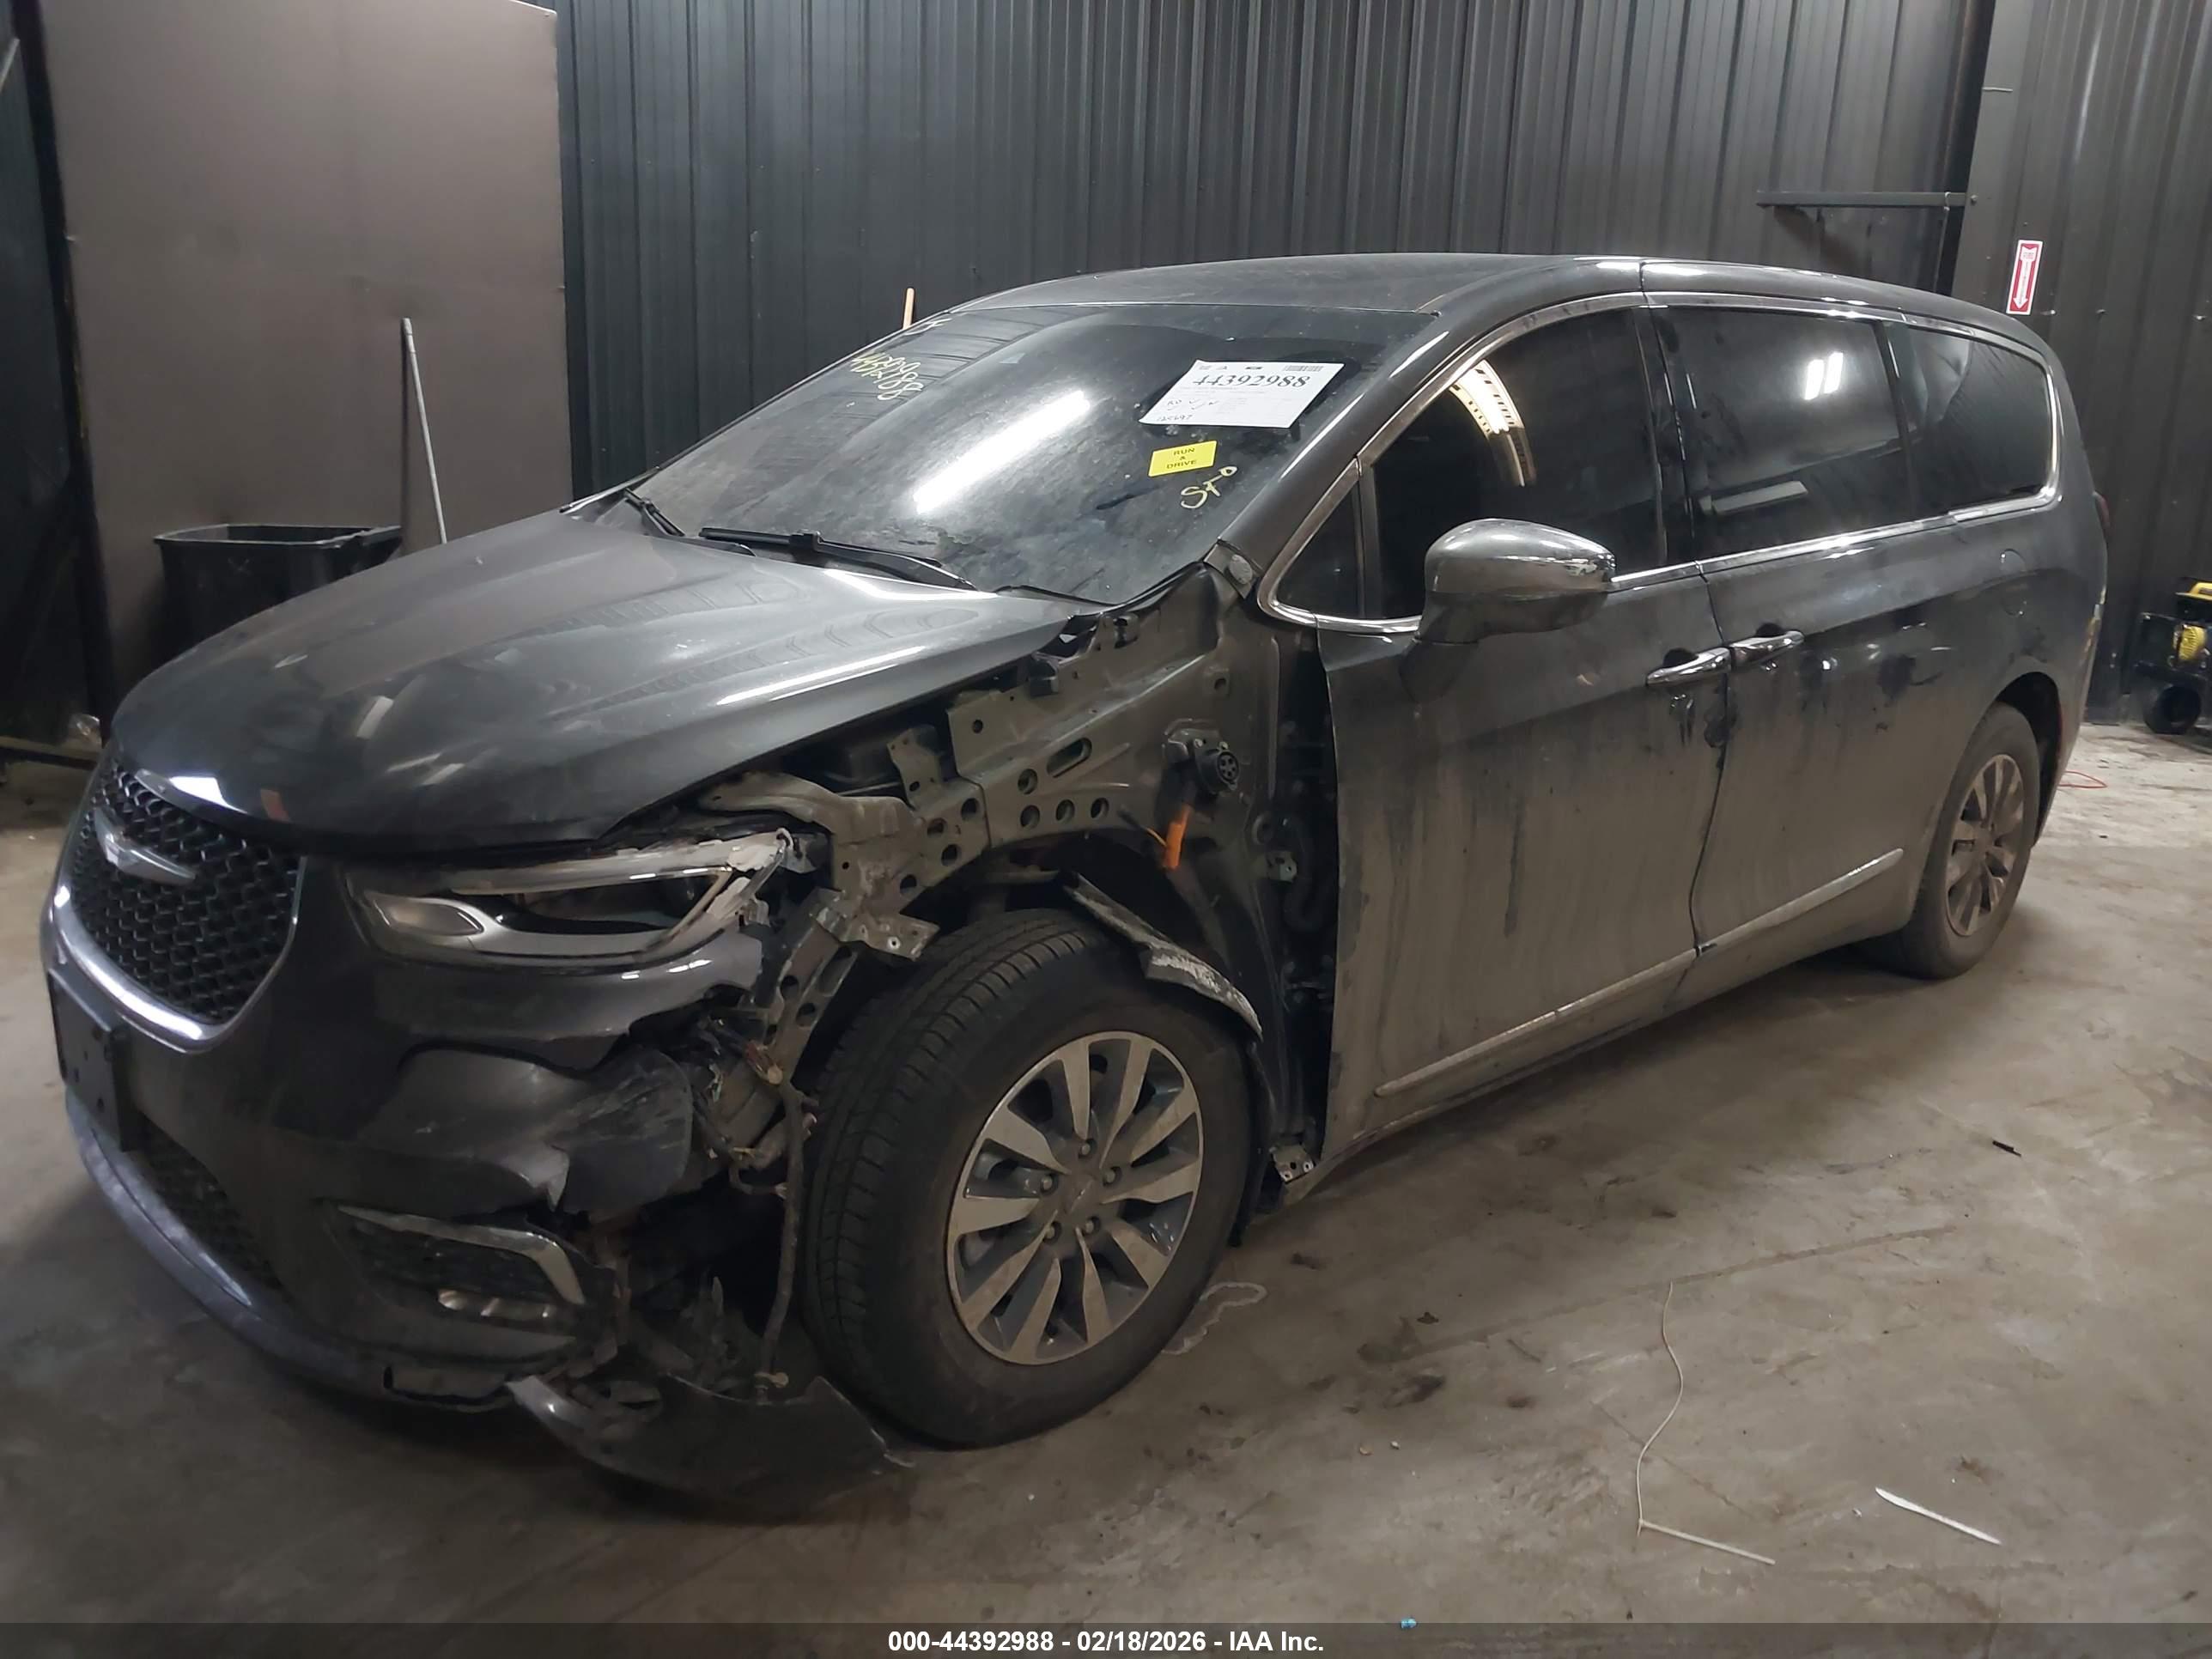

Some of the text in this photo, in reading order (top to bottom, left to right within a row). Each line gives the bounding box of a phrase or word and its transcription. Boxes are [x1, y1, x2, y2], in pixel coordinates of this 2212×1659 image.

[1193, 374, 1310, 387] 44392988
[1173, 447, 1195, 456] RUN
[1166, 459, 1197, 470] DRIVE
